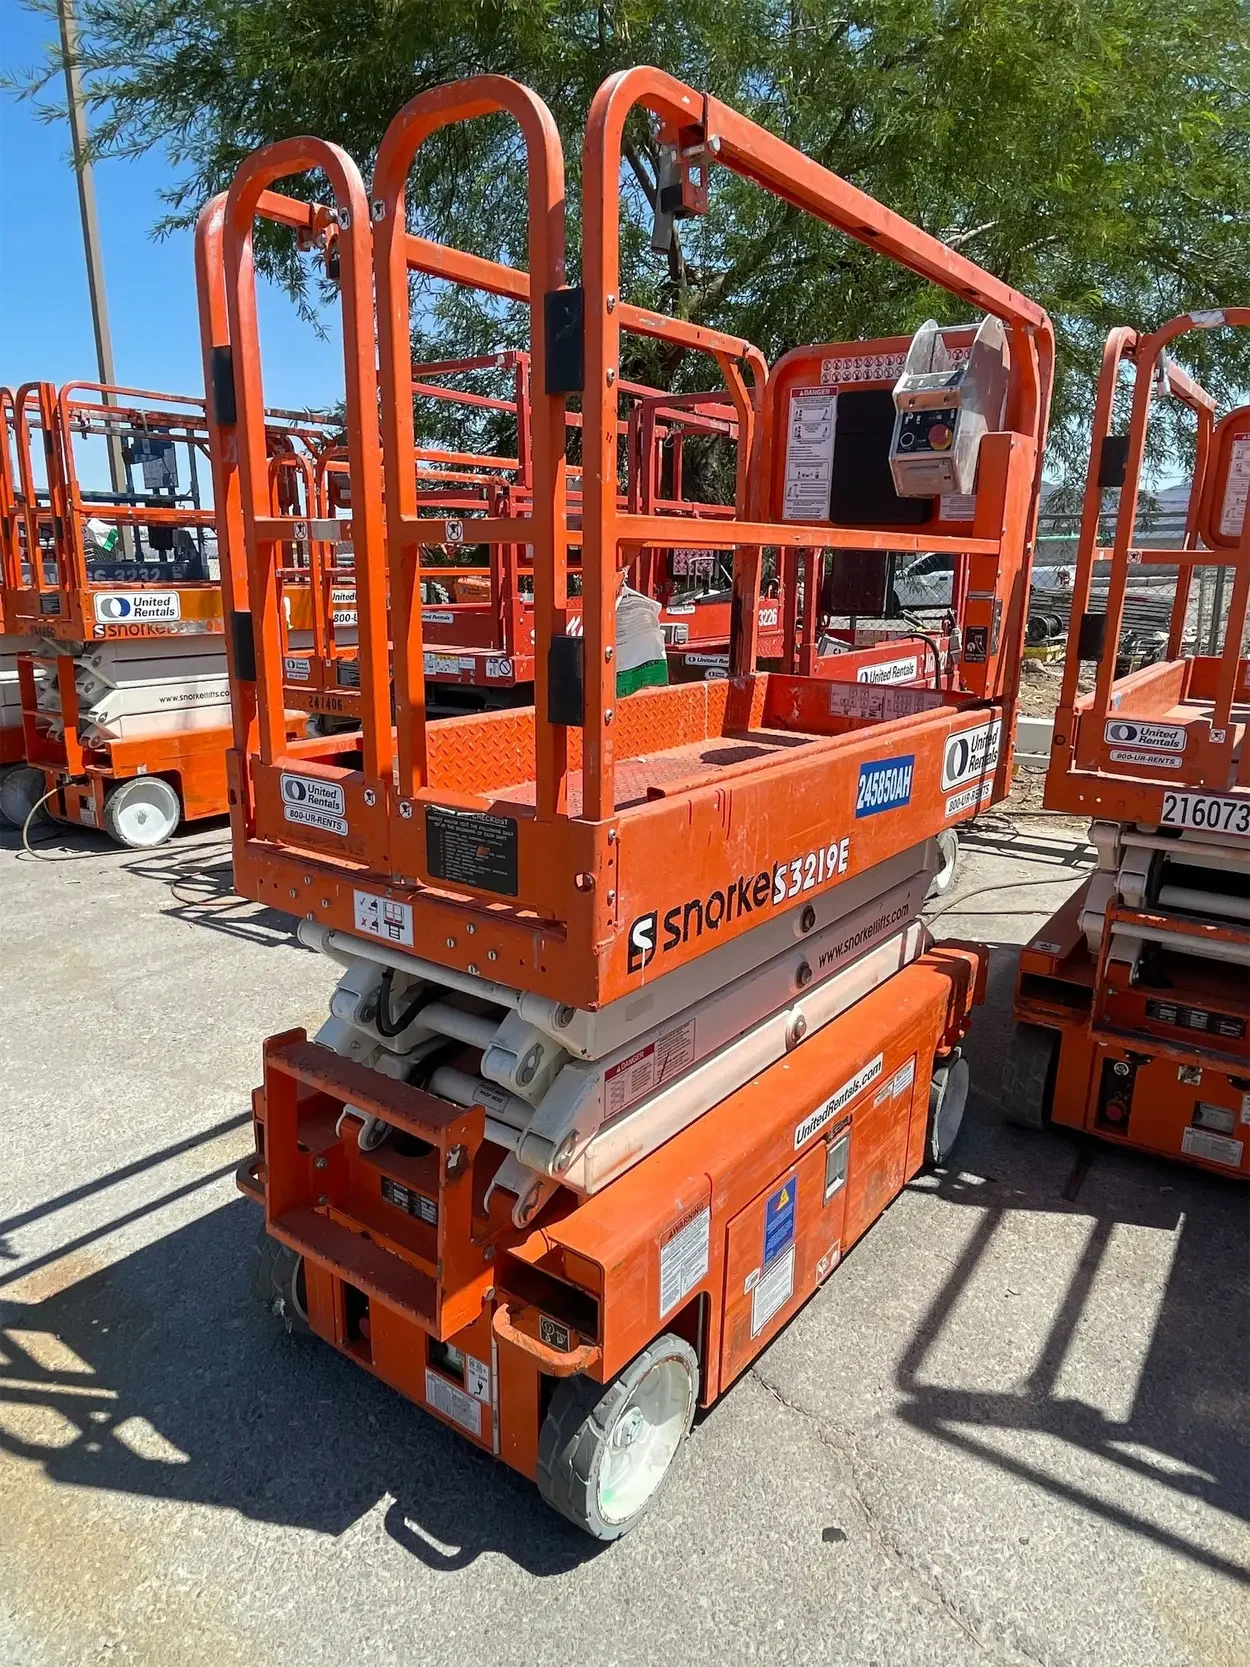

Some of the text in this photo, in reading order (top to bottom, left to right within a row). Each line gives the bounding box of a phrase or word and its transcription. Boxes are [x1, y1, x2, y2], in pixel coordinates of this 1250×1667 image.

[804, 388, 831, 396] DANGER
[133, 596, 171, 607] United
[134, 607, 175, 617] Rentals
[758, 608, 778, 627] 3226
[870, 662, 914, 684] United Rentals
[970, 726, 999, 753] United
[1138, 735, 1180, 748] Rentals
[1140, 727, 1178, 739] United
[968, 749, 998, 773] Rentals
[1116, 753, 1176, 765] 800-UR-RENTS
[307, 784, 337, 799] United
[856, 765, 912, 810] 245850AH
[308, 794, 340, 810] Rentals
[289, 809, 342, 830] 800-UR-RENTS
[1162, 794, 1250, 832] 216073
[663, 860, 778, 952] snorkel
[773, 837, 850, 906] S3219E
[818, 903, 909, 969] www.snorkellifts.com
[620, 1050, 645, 1071] DANGER
[796, 1061, 882, 1144] UnitedRentals.com
[672, 1202, 704, 1234] WARNING
